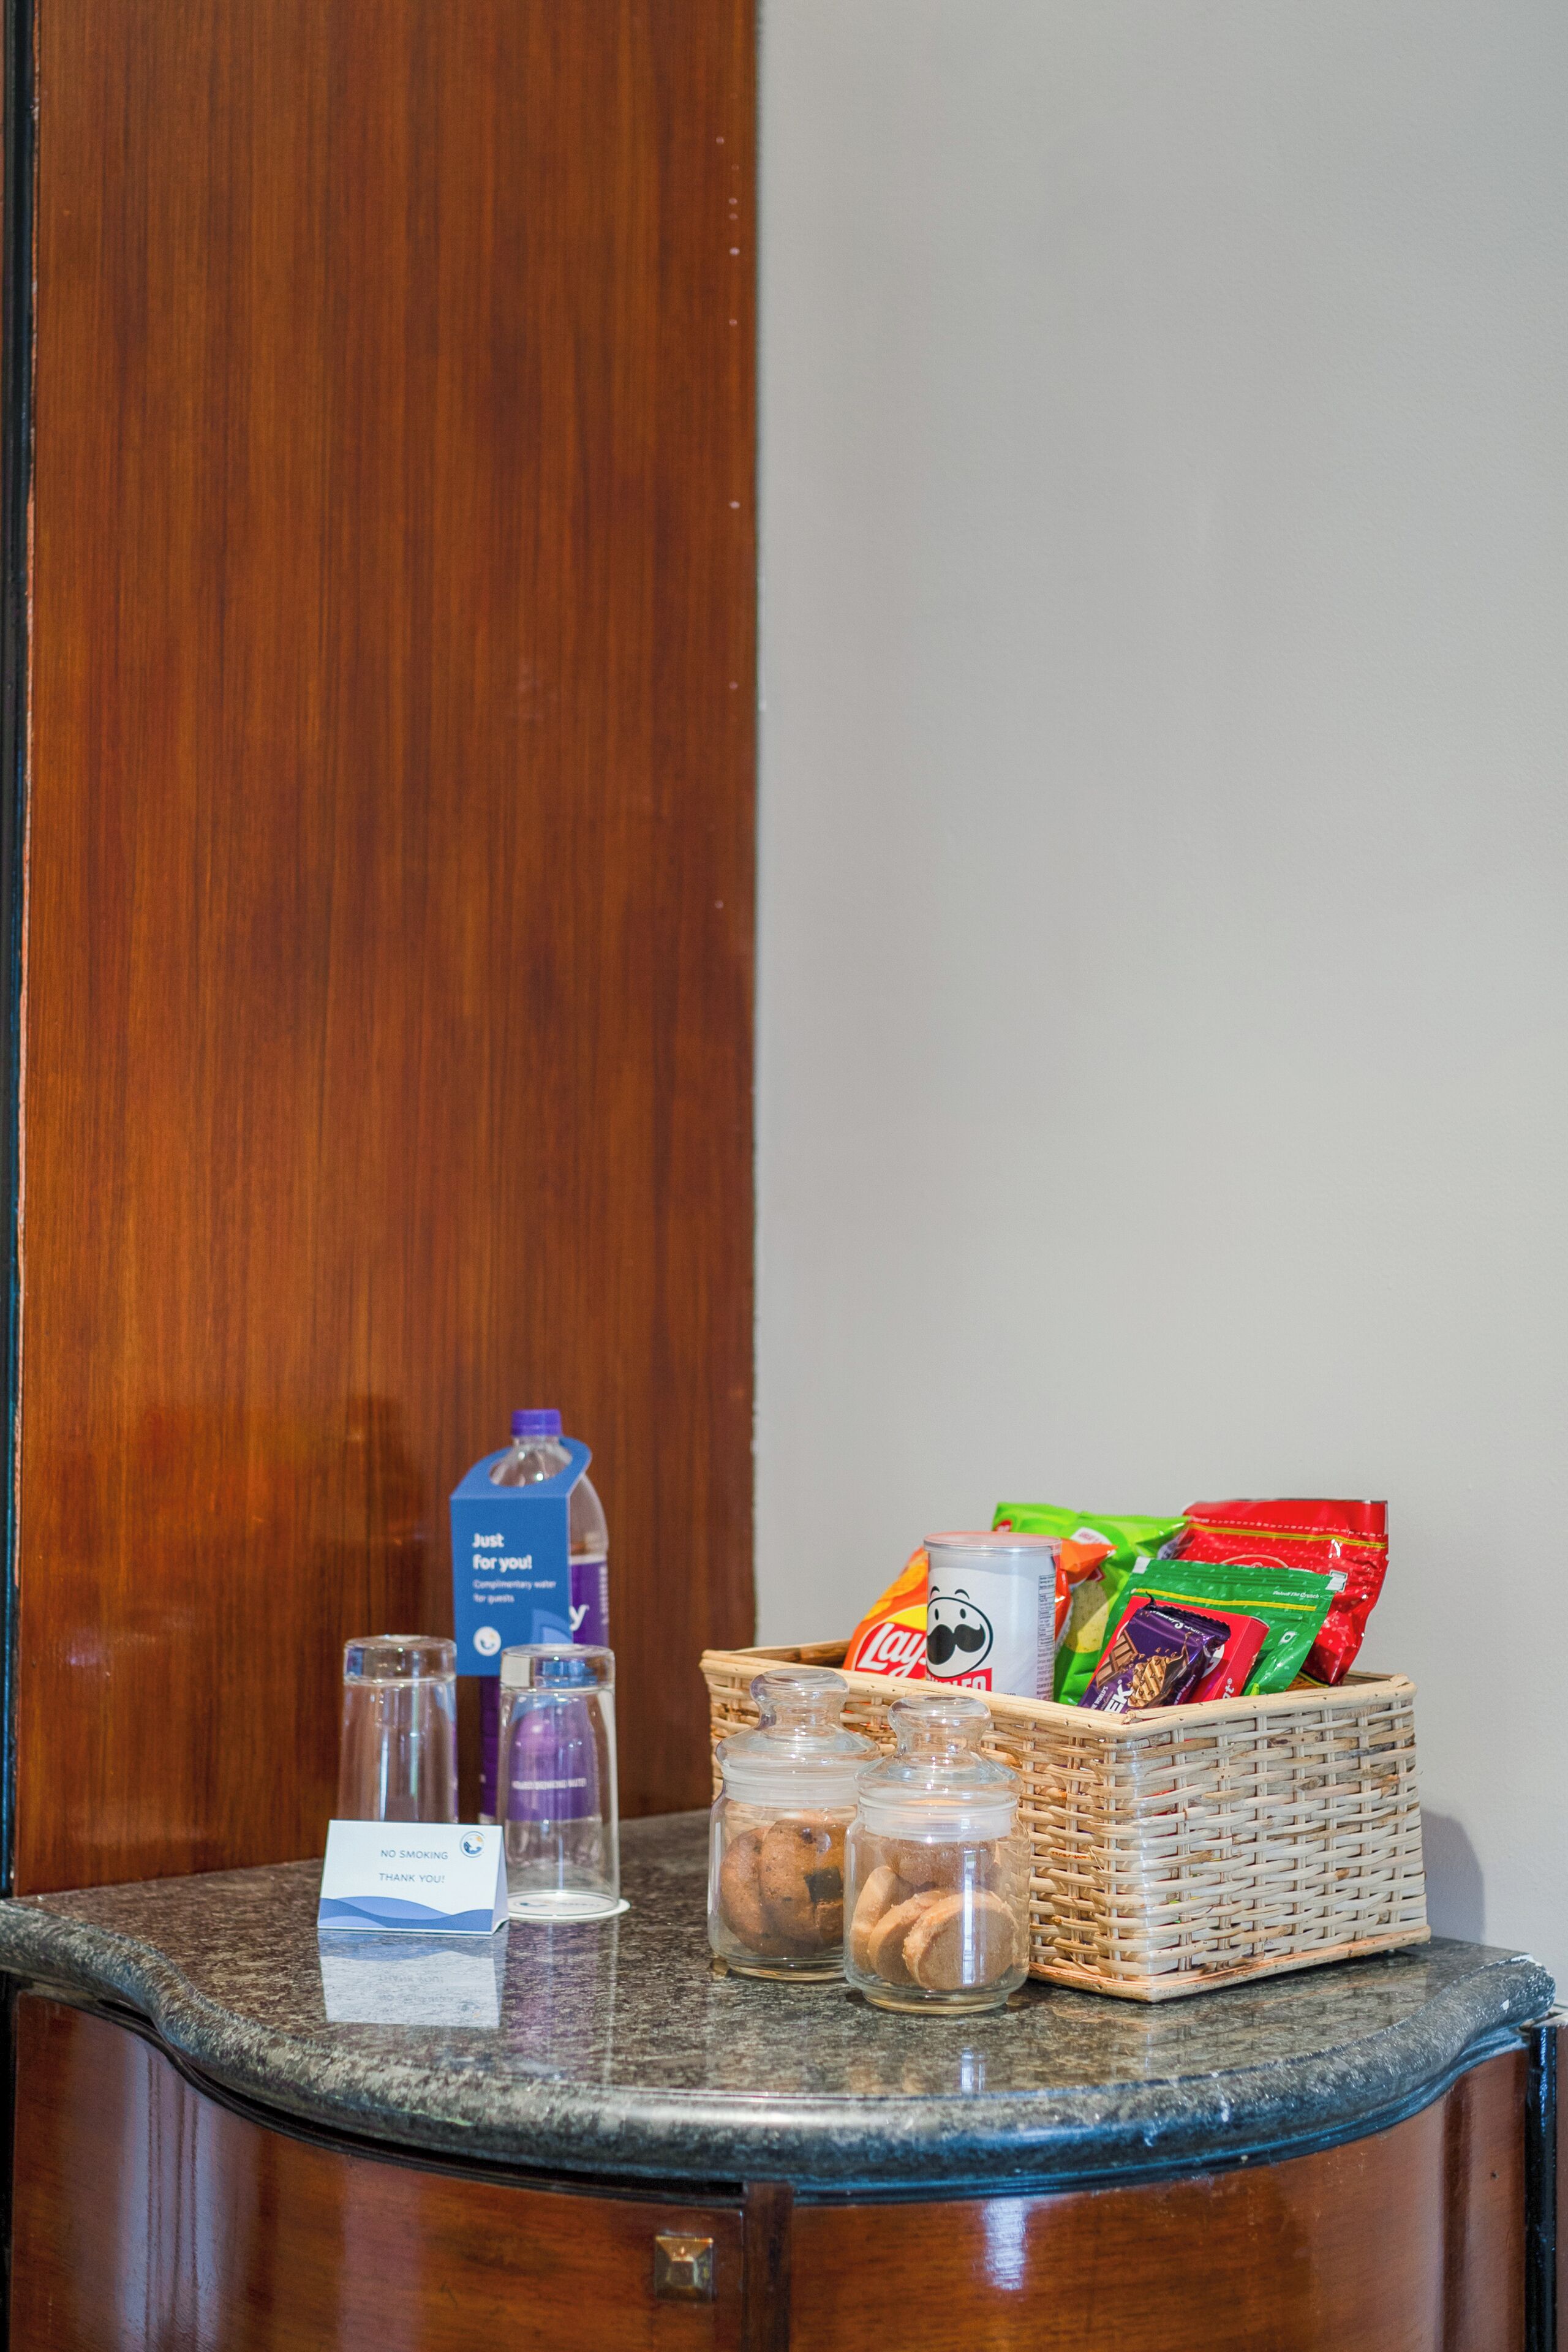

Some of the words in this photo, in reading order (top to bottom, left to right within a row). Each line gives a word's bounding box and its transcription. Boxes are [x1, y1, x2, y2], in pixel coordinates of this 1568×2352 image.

[472, 1532, 505, 1548] Just
[473, 1554, 497, 1570] for
[499, 1555, 532, 1573] you!
[472, 1580, 532, 1591] Complimentary
[534, 1580, 557, 1589] water
[473, 1593, 486, 1603] for
[488, 1594, 514, 1604] guests
[857, 1623, 927, 1678] Lay
[1094, 1686, 1109, 1705] WORLD'S
[380, 1849, 396, 1858] NO
[399, 1850, 448, 1860] SMOKING
[379, 1872, 415, 1882] THANK
[419, 1874, 445, 1883] YOU!
